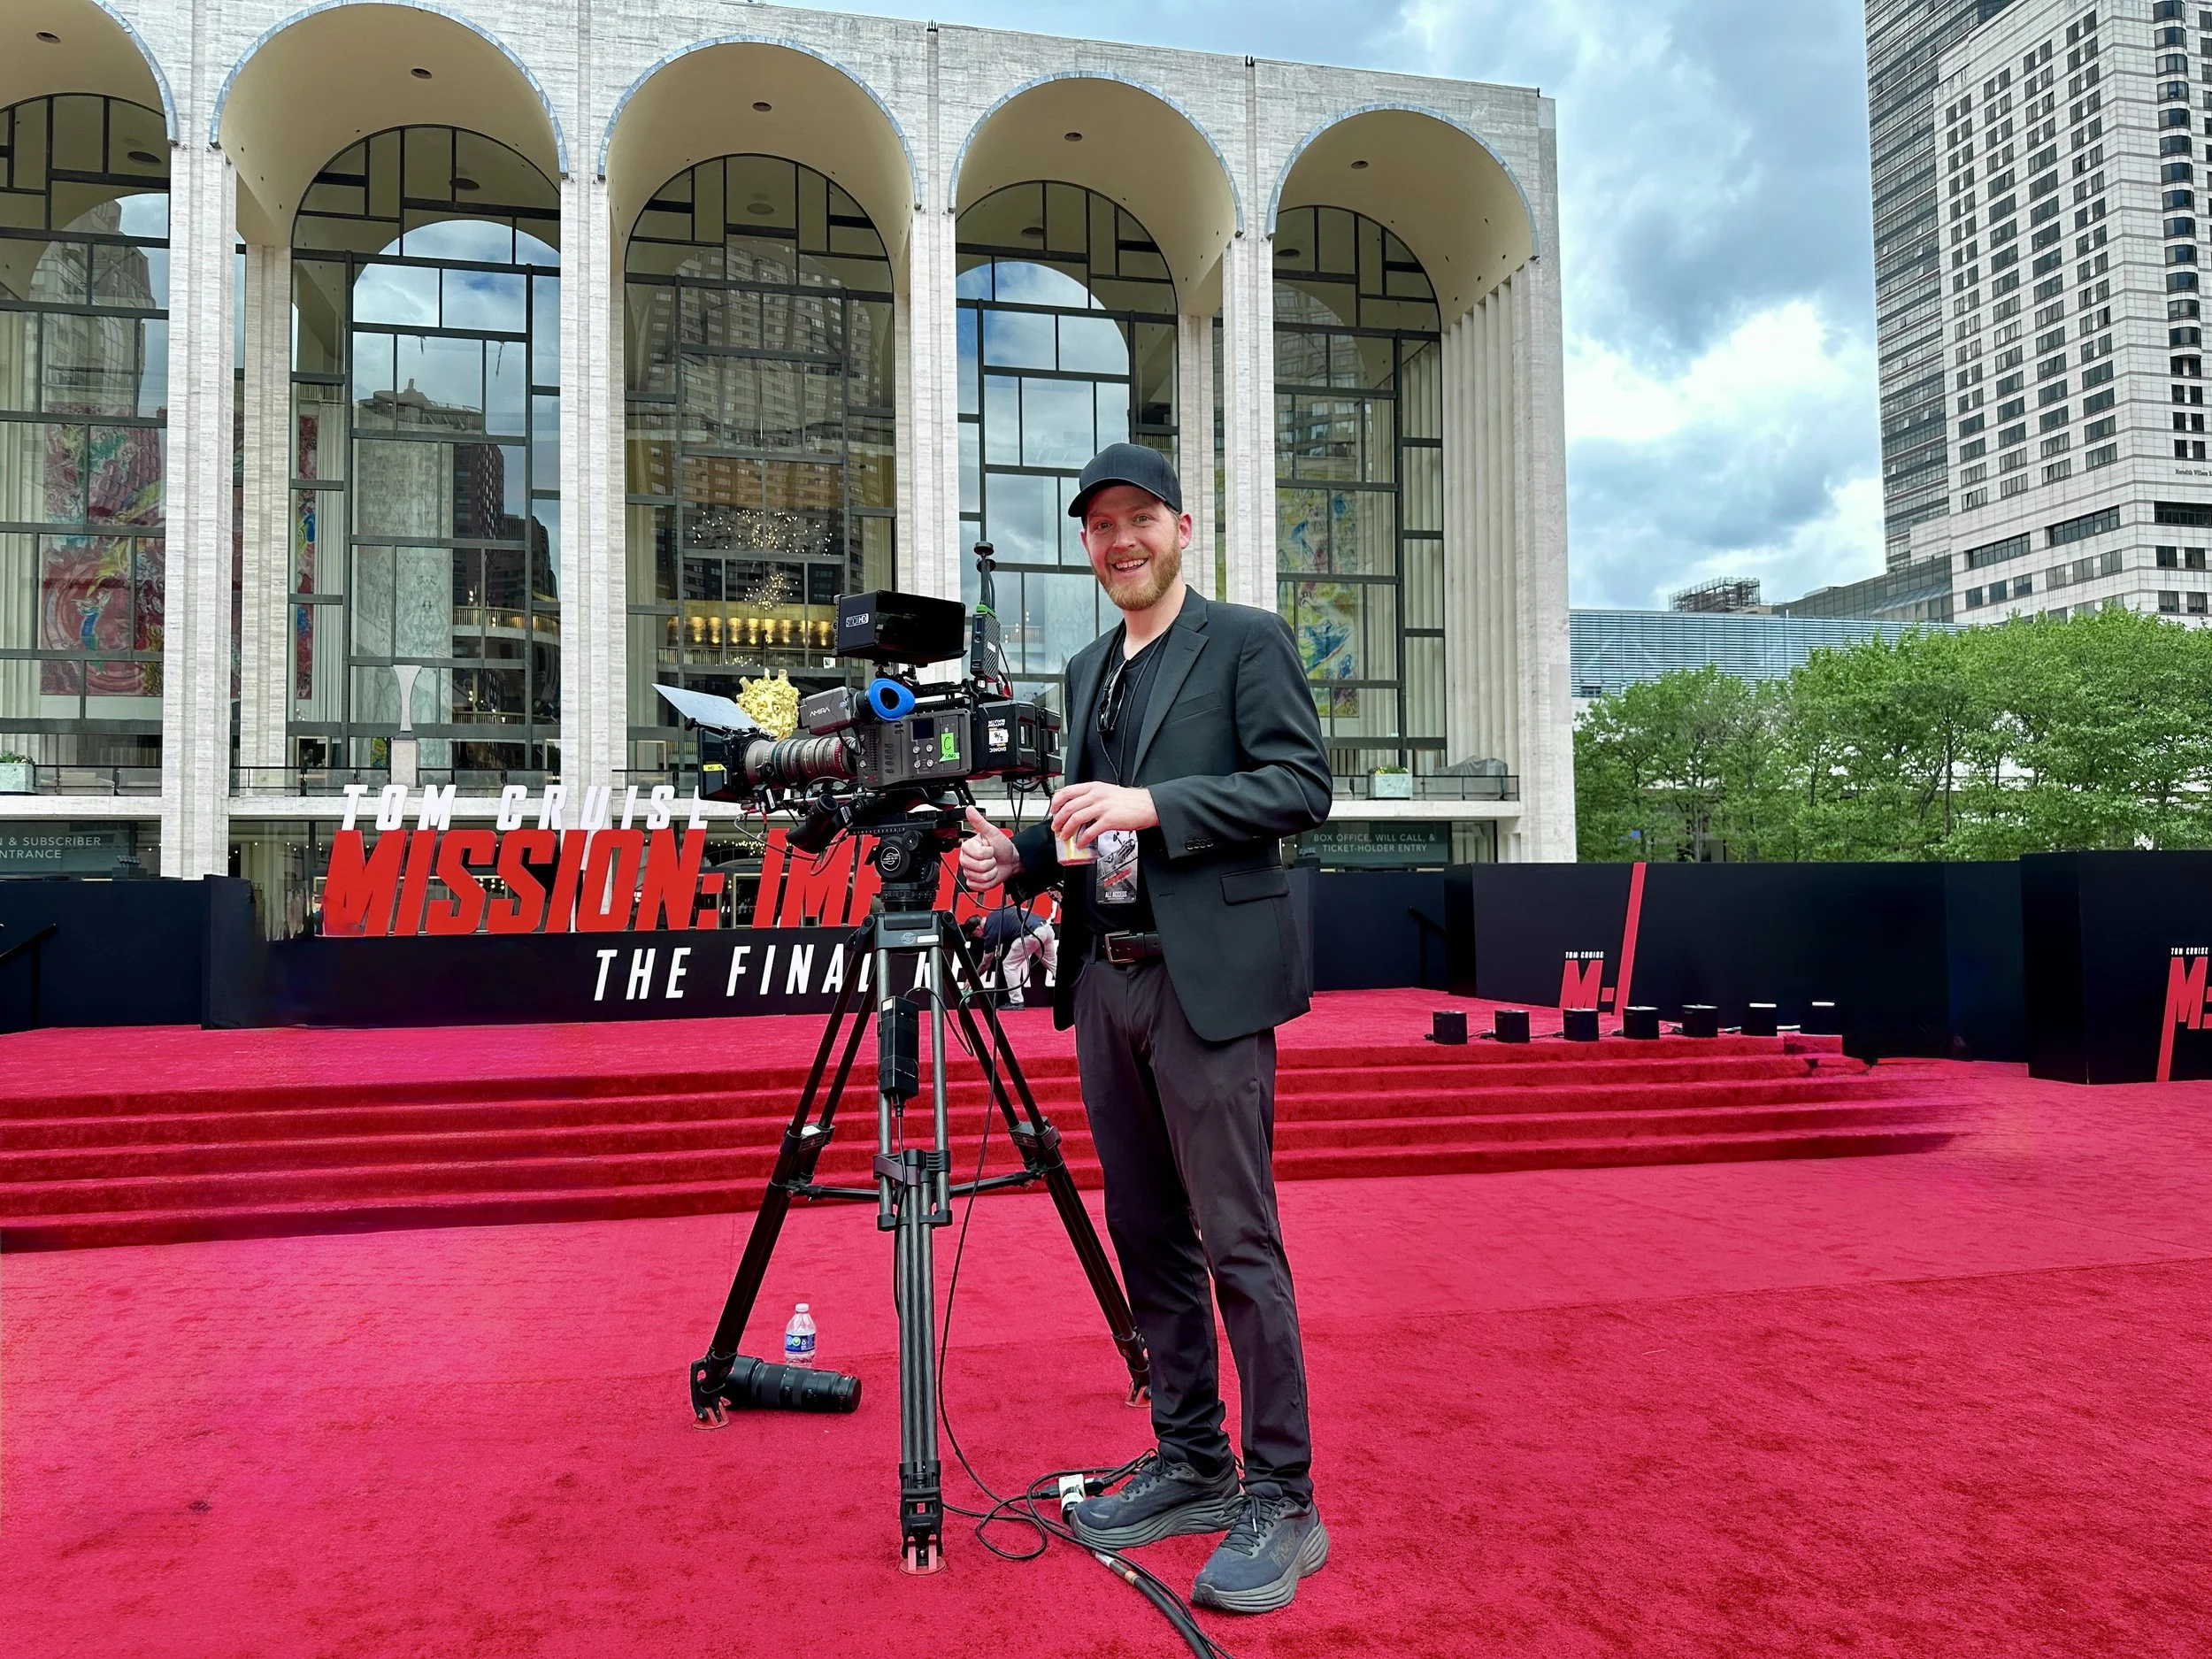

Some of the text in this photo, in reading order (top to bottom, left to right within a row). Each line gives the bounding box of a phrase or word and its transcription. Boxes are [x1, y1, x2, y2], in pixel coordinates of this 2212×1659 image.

[810, 707, 830, 717] AMIRA
[943, 736, 951, 750] C
[342, 784, 709, 831] TOM CRUISE
[8, 837, 17, 846] &
[23, 836, 101, 846] SUBSCRIBER
[1400, 833, 1425, 843] CALL,
[1322, 844, 1395, 853] TICKET-HOLDER
[323, 829, 724, 936] MISSION:
[1580, 950, 1604, 959] CRUISE
[595, 947, 691, 1002] THE
[726, 943, 871, 997] FINAL
